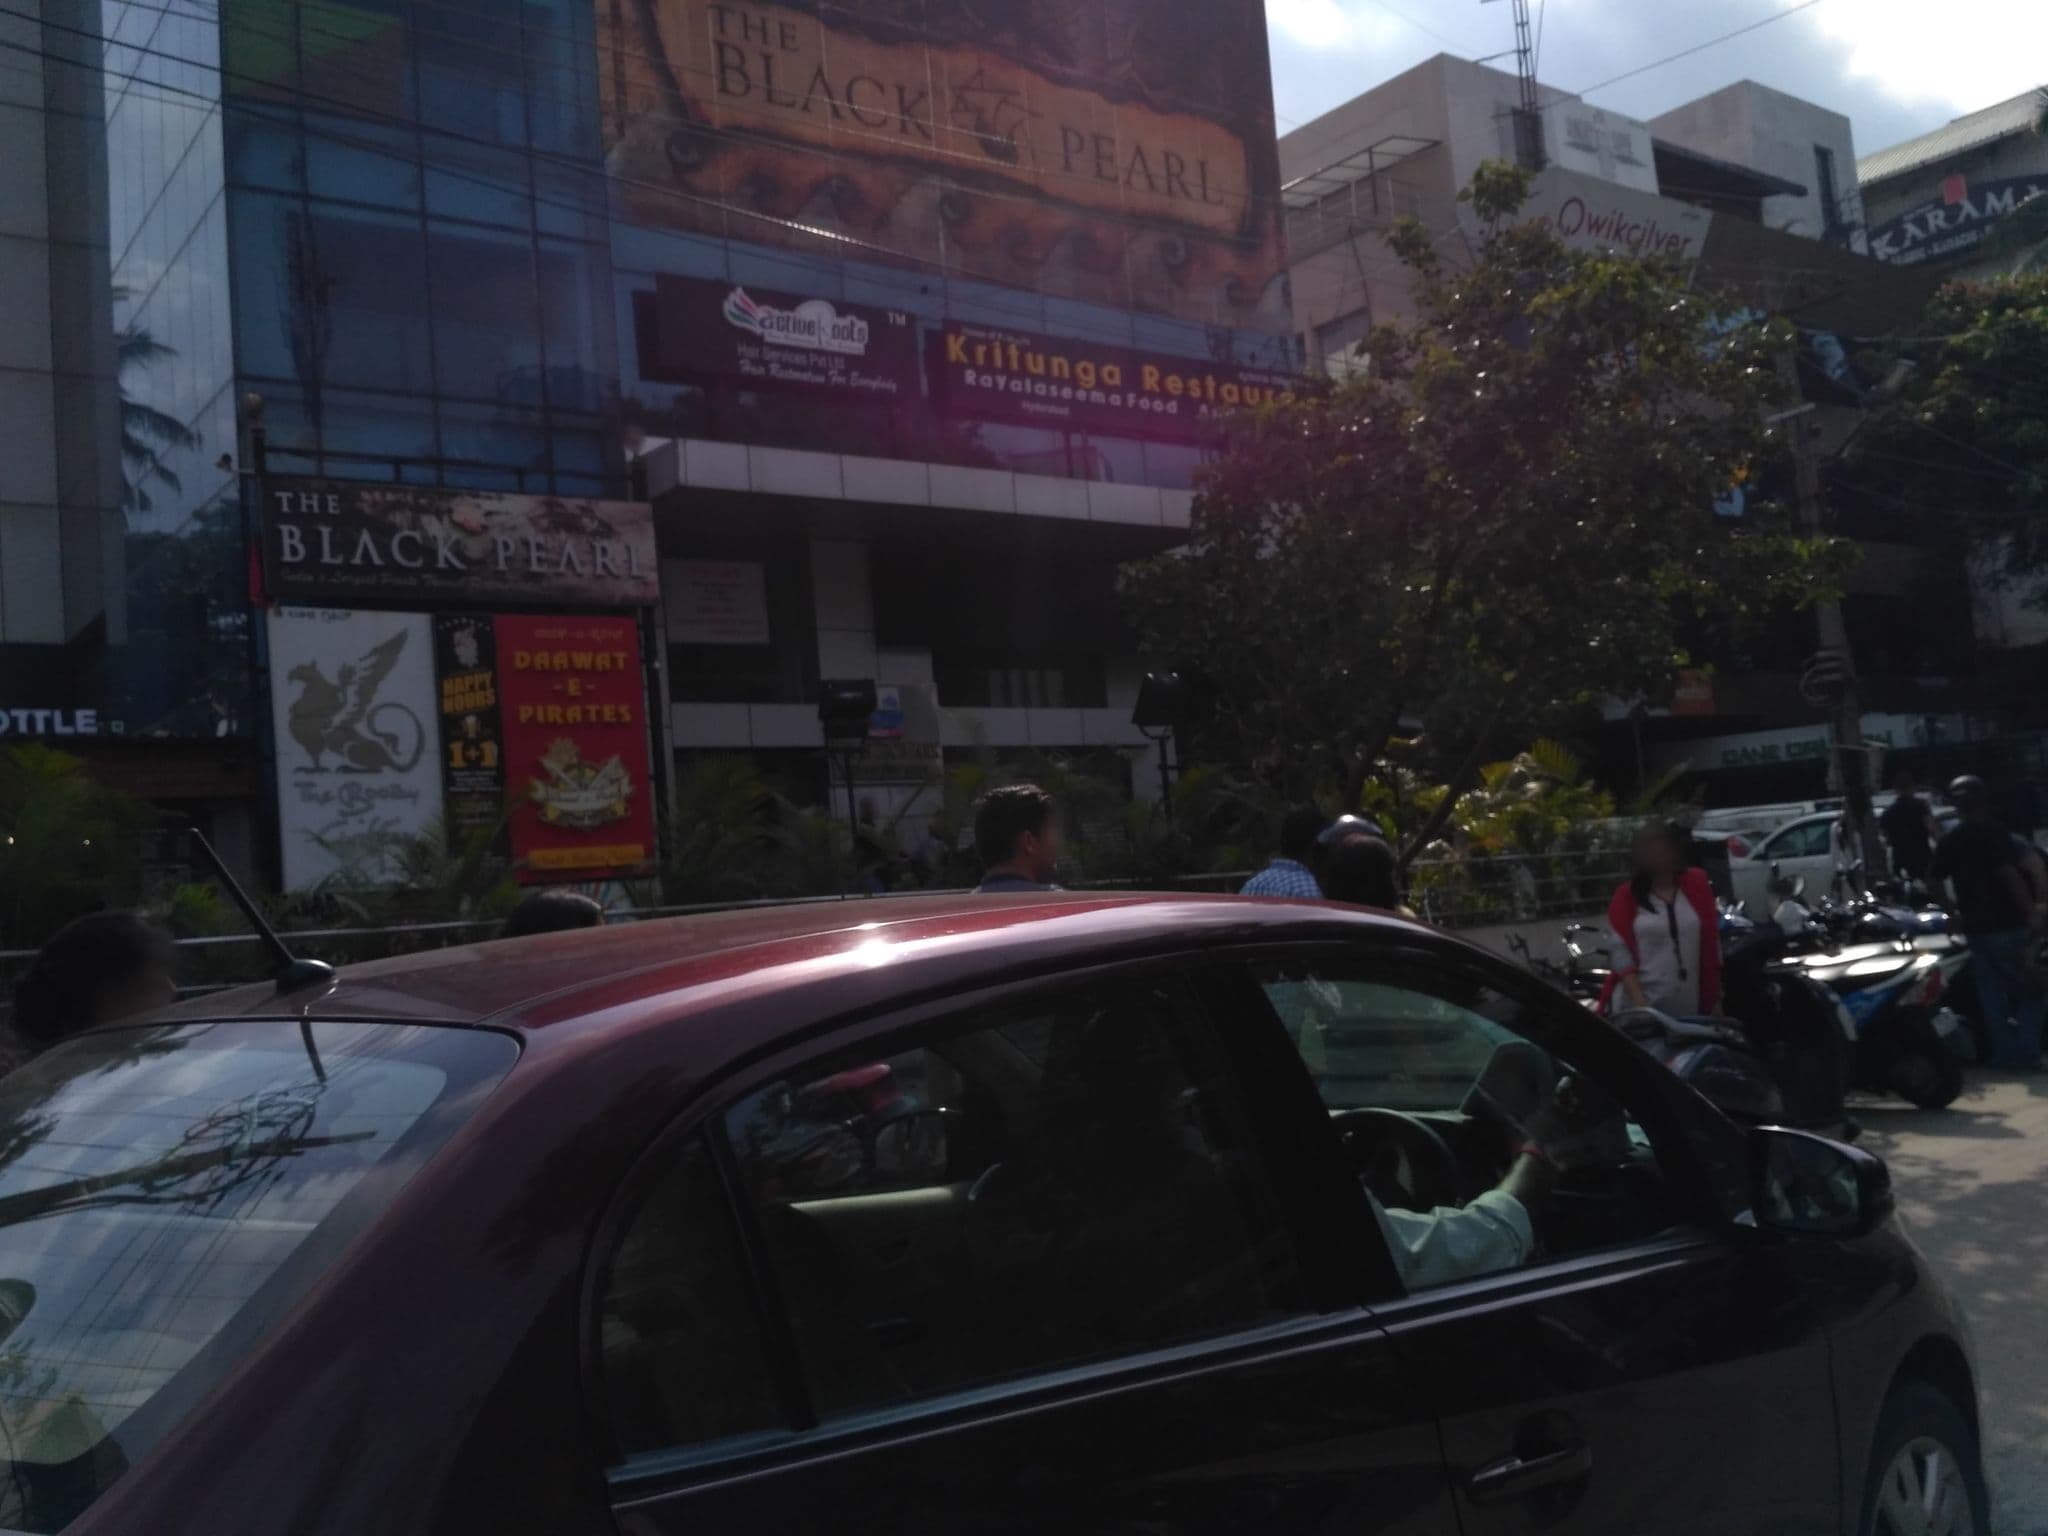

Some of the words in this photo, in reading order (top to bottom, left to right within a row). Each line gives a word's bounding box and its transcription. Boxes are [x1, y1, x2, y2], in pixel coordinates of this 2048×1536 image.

[707, 3, 800, 51] THE
[713, 39, 934, 142] BLACK
[1059, 122, 1225, 207] PEARL
[945, 333, 1121, 391] Kritunga
[273, 490, 341, 515] THE
[278, 523, 468, 571] BLACK
[513, 649, 629, 672] DAAWAT
[517, 703, 632, 725] PIRATES
